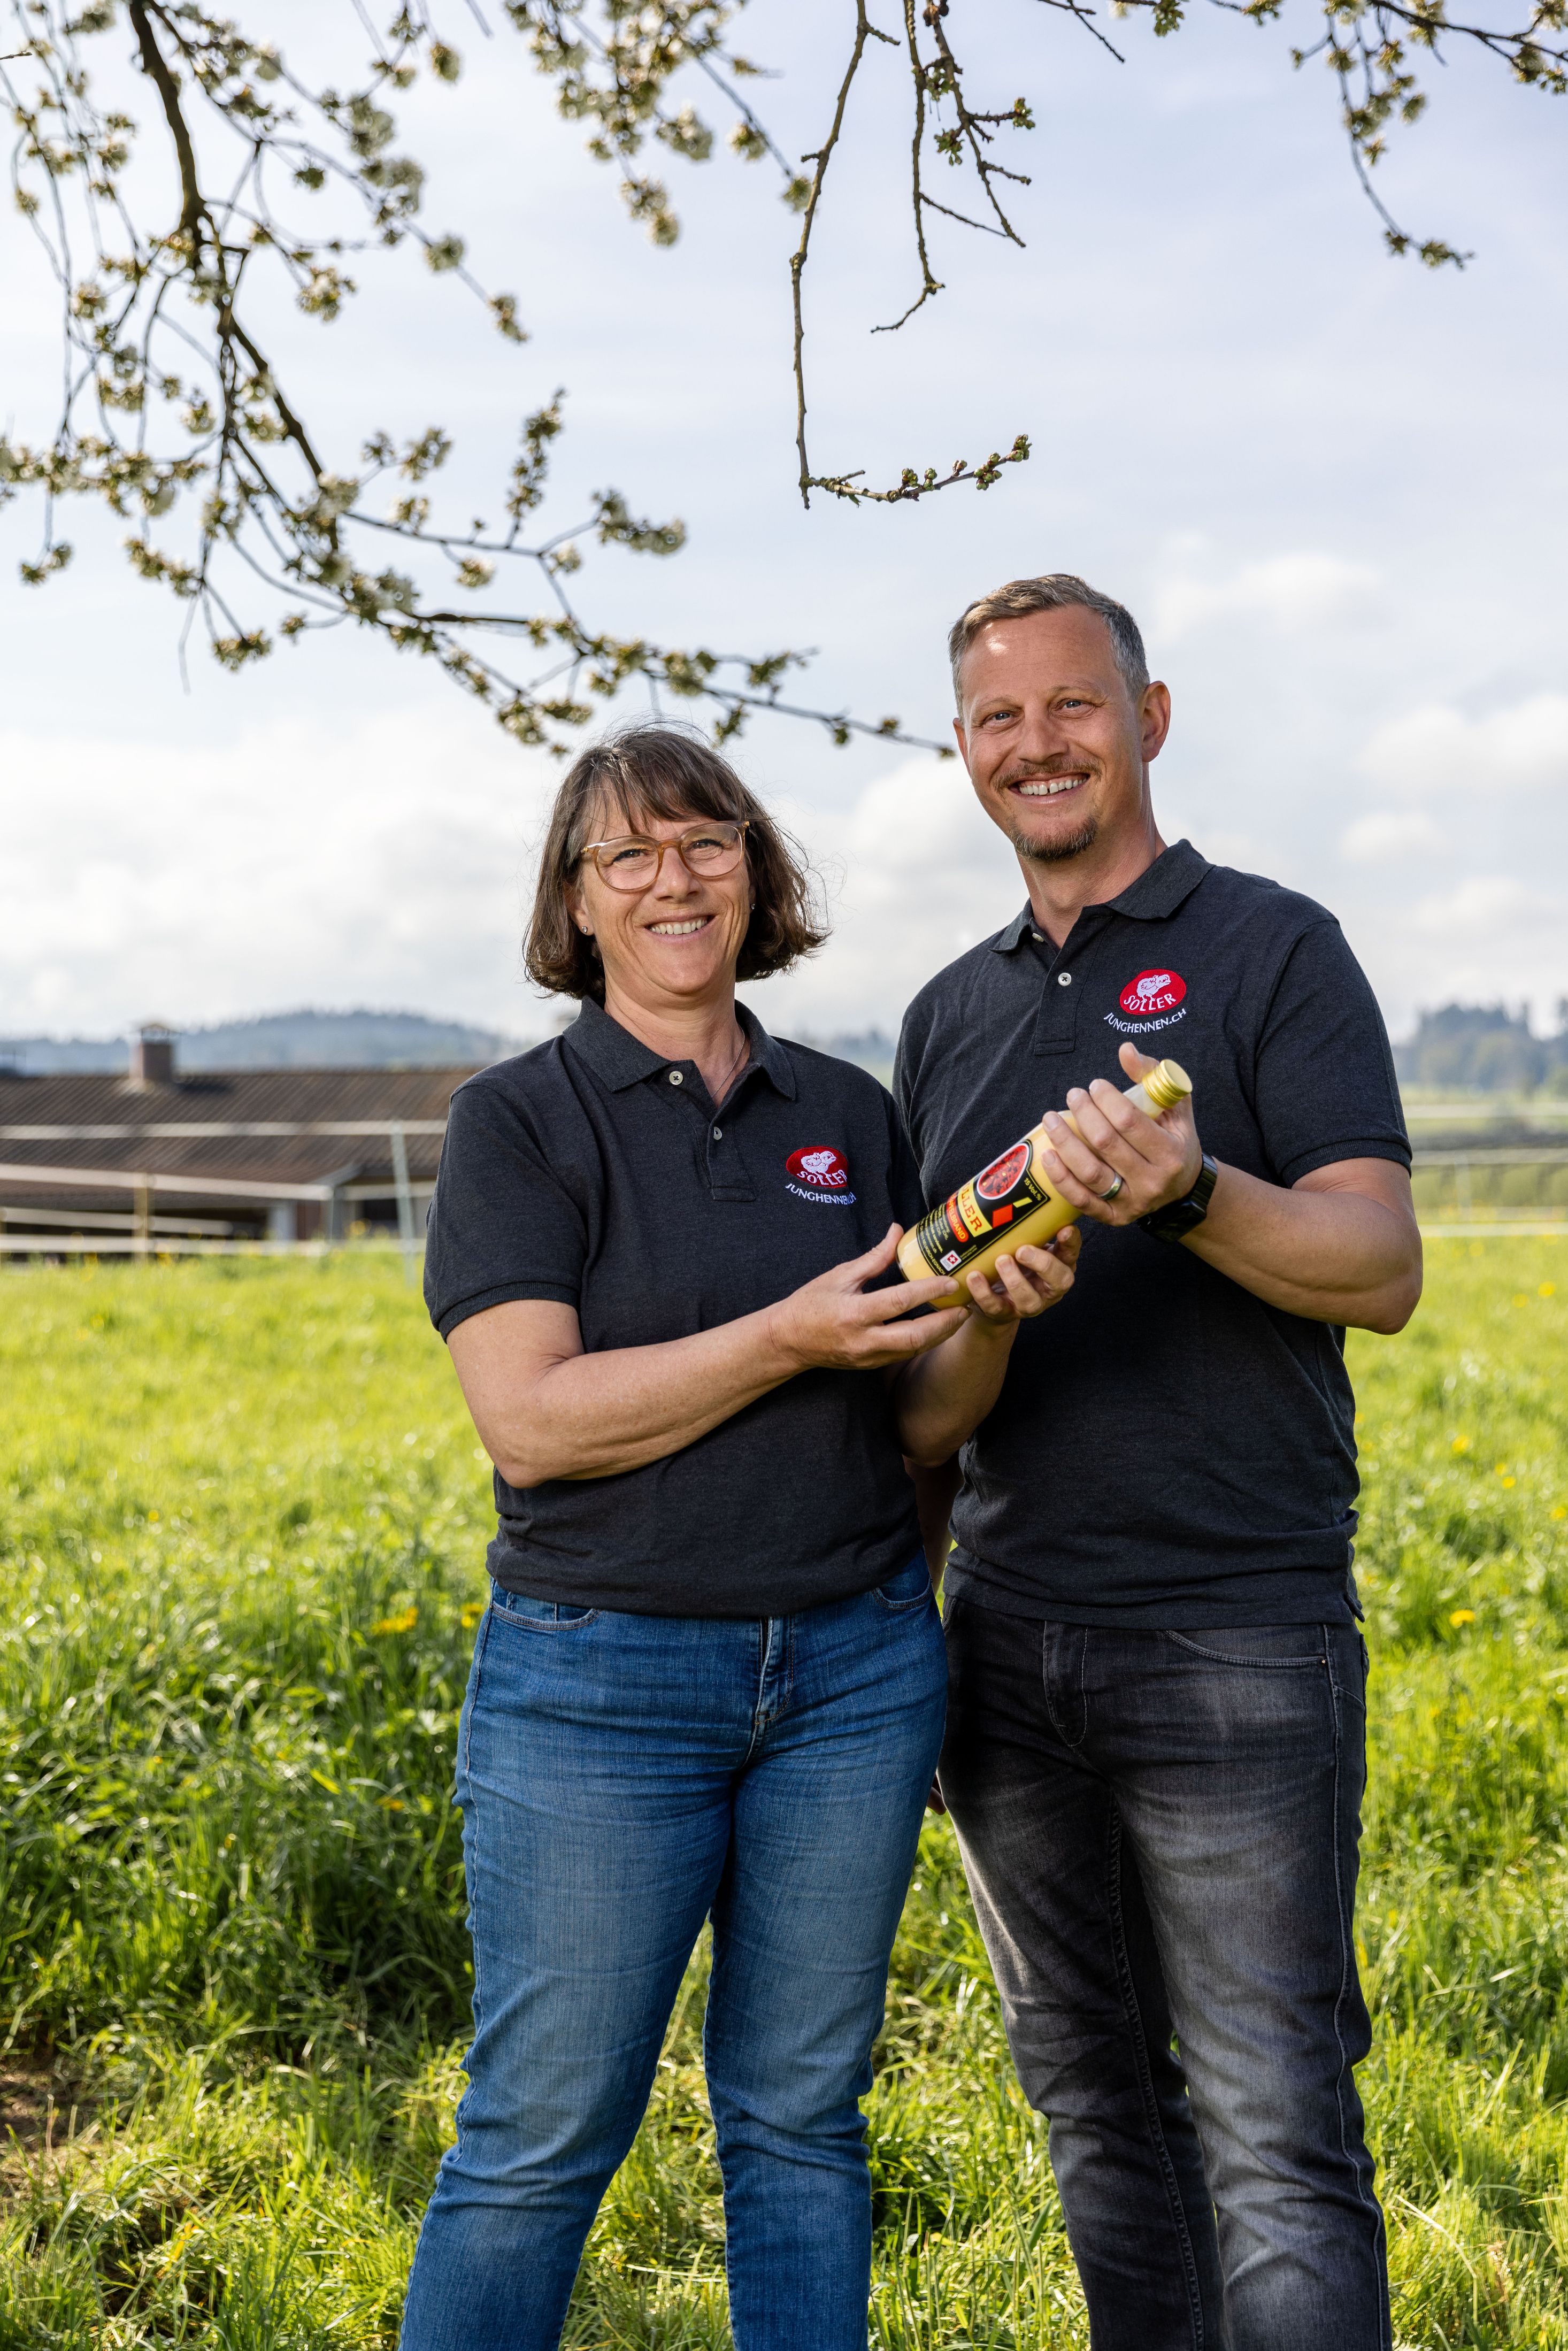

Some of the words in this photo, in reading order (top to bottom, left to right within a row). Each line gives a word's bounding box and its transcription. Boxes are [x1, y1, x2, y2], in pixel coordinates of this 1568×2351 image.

[1124, 993, 1177, 1012] SOLLER
[1103, 1008, 1187, 1033] JUNGHENNEN.CH
[797, 1169, 848, 1185] SOLLER
[1024, 1178, 1031, 1186] 15
[962, 1182, 982, 1231] OLLER
